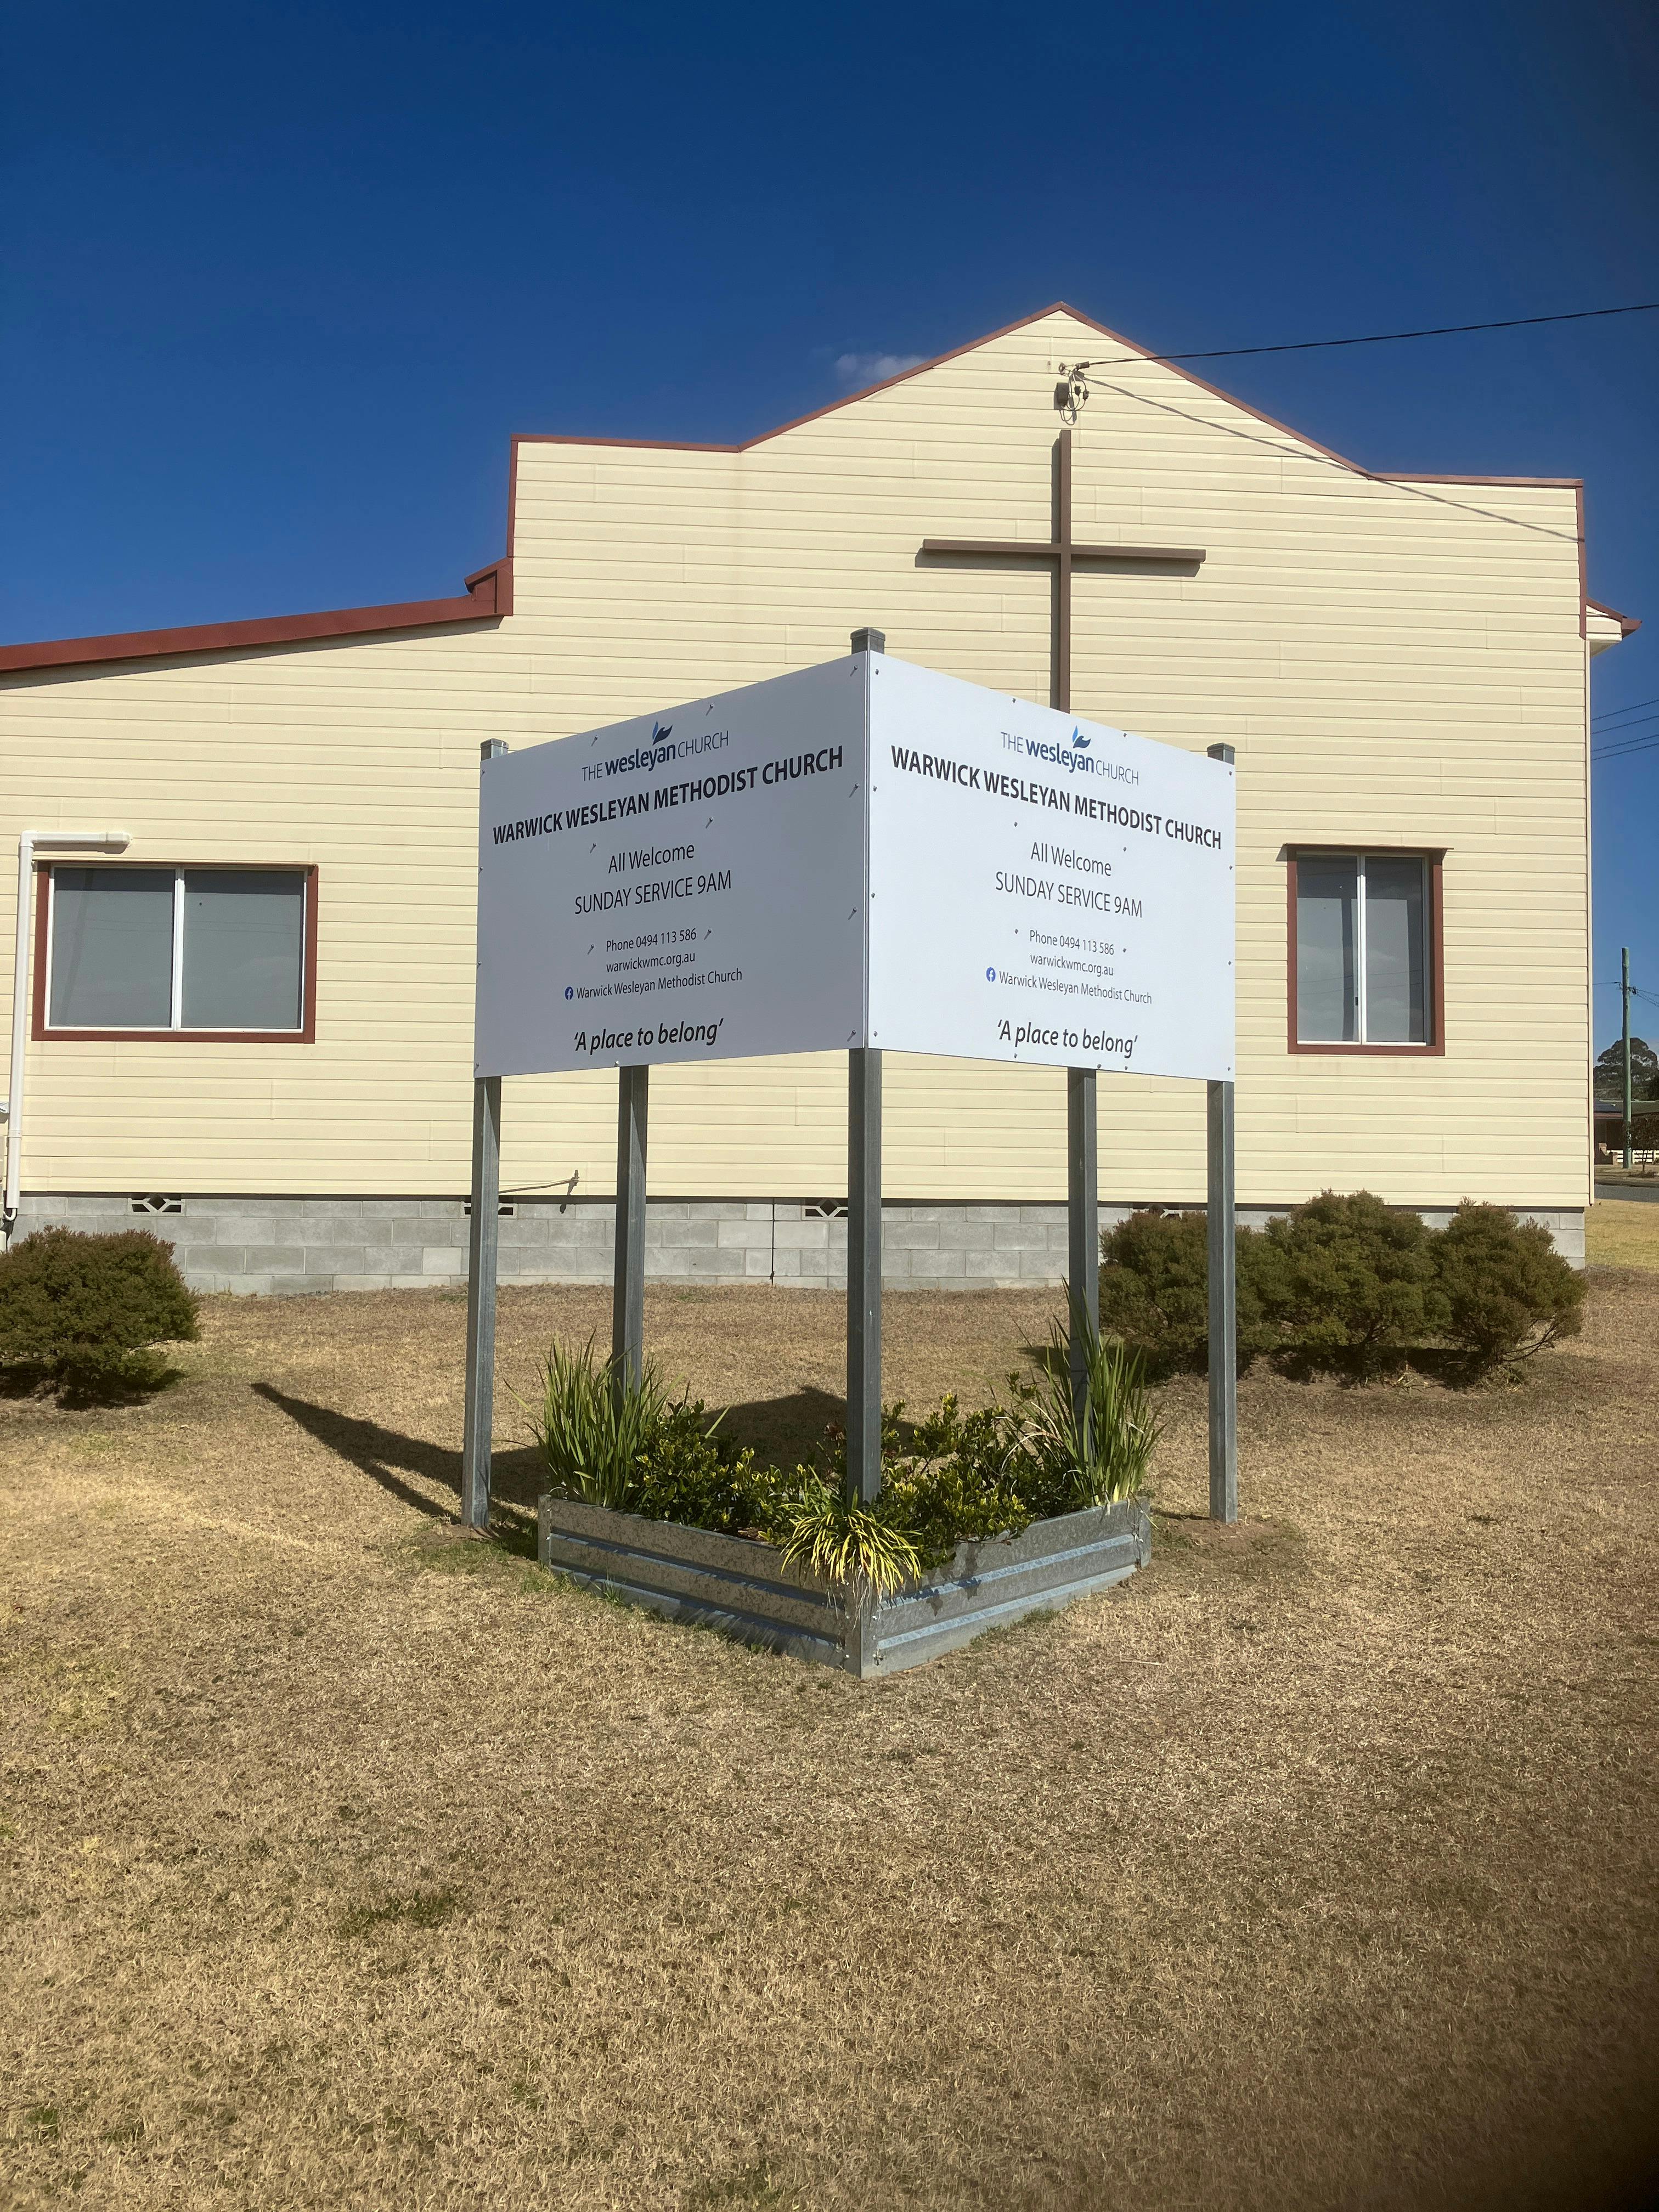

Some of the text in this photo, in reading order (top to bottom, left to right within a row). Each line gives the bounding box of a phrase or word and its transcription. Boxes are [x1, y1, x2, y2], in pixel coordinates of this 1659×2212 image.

[581, 730, 729, 782] THE wesleyan CHURCH
[1000, 731, 1139, 786] THE wesleyan CHURCH
[493, 745, 843, 845] WARWICK WESLEYAN METHODIST CHURCH
[890, 744, 1221, 850] WARWICK WESLEYAN METHODIST CHURCH
[608, 844, 695, 874] All Welcome
[1030, 842, 1112, 877] All Welcome
[574, 870, 731, 915] SUNDAY SERVICE 9AM
[995, 871, 1142, 918] SUNDAY SERVICE 9AM
[606, 928, 697, 952] Phone 0494 113 586
[1030, 929, 1114, 956] Phone 0494 113 586
[606, 952, 695, 973] warwickwmc.org.au
[1030, 954, 1114, 978] warwickwmc.org.au
[576, 967, 742, 999] Warwick Wesleyan Methodist Church
[998, 970, 1152, 1005] Warwick Wesleyan Methodist Church
[589, 1028, 633, 1056] place
[637, 1028, 654, 1046] to
[1014, 1022, 1059, 1047] place
[1062, 1028, 1079, 1048] to
